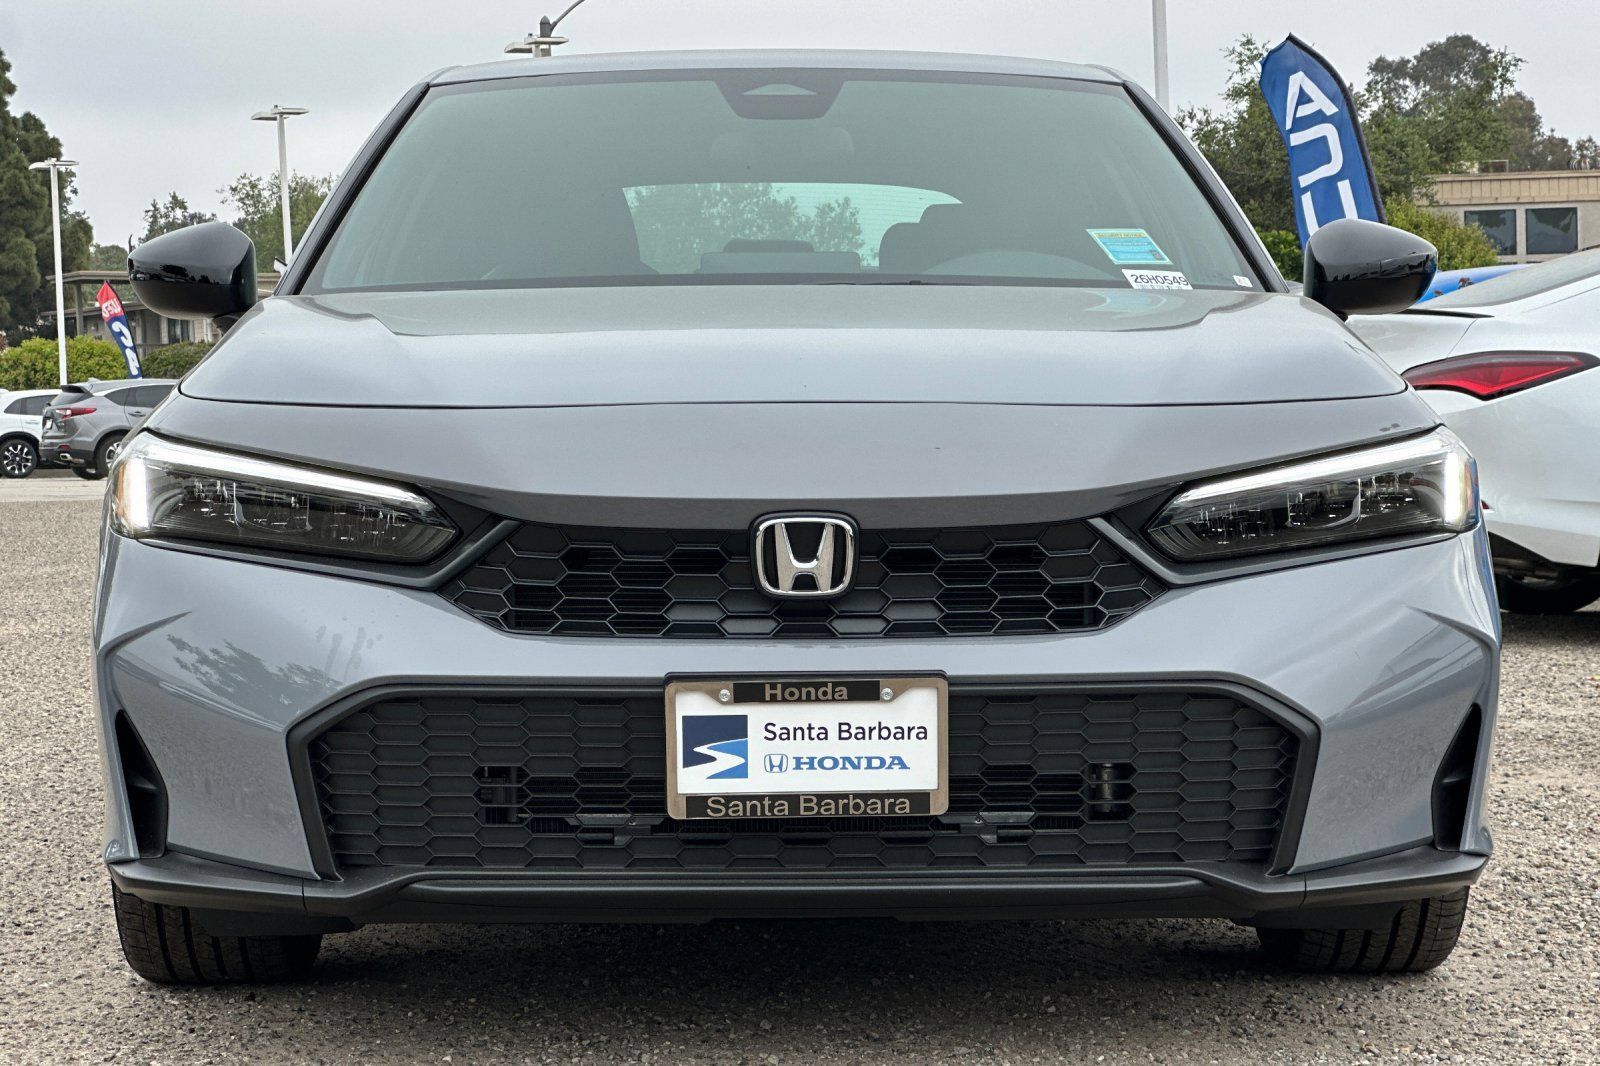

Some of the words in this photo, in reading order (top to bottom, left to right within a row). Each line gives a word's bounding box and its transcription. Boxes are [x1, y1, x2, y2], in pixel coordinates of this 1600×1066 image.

[1130, 274, 1189, 286] 26H0549
[764, 683, 848, 701] Honda
[763, 722, 829, 741] Santa
[838, 721, 928, 741] Barbara
[793, 756, 911, 771] HONDA
[706, 796, 789, 818] Santa
[799, 794, 911, 816] Barbara
